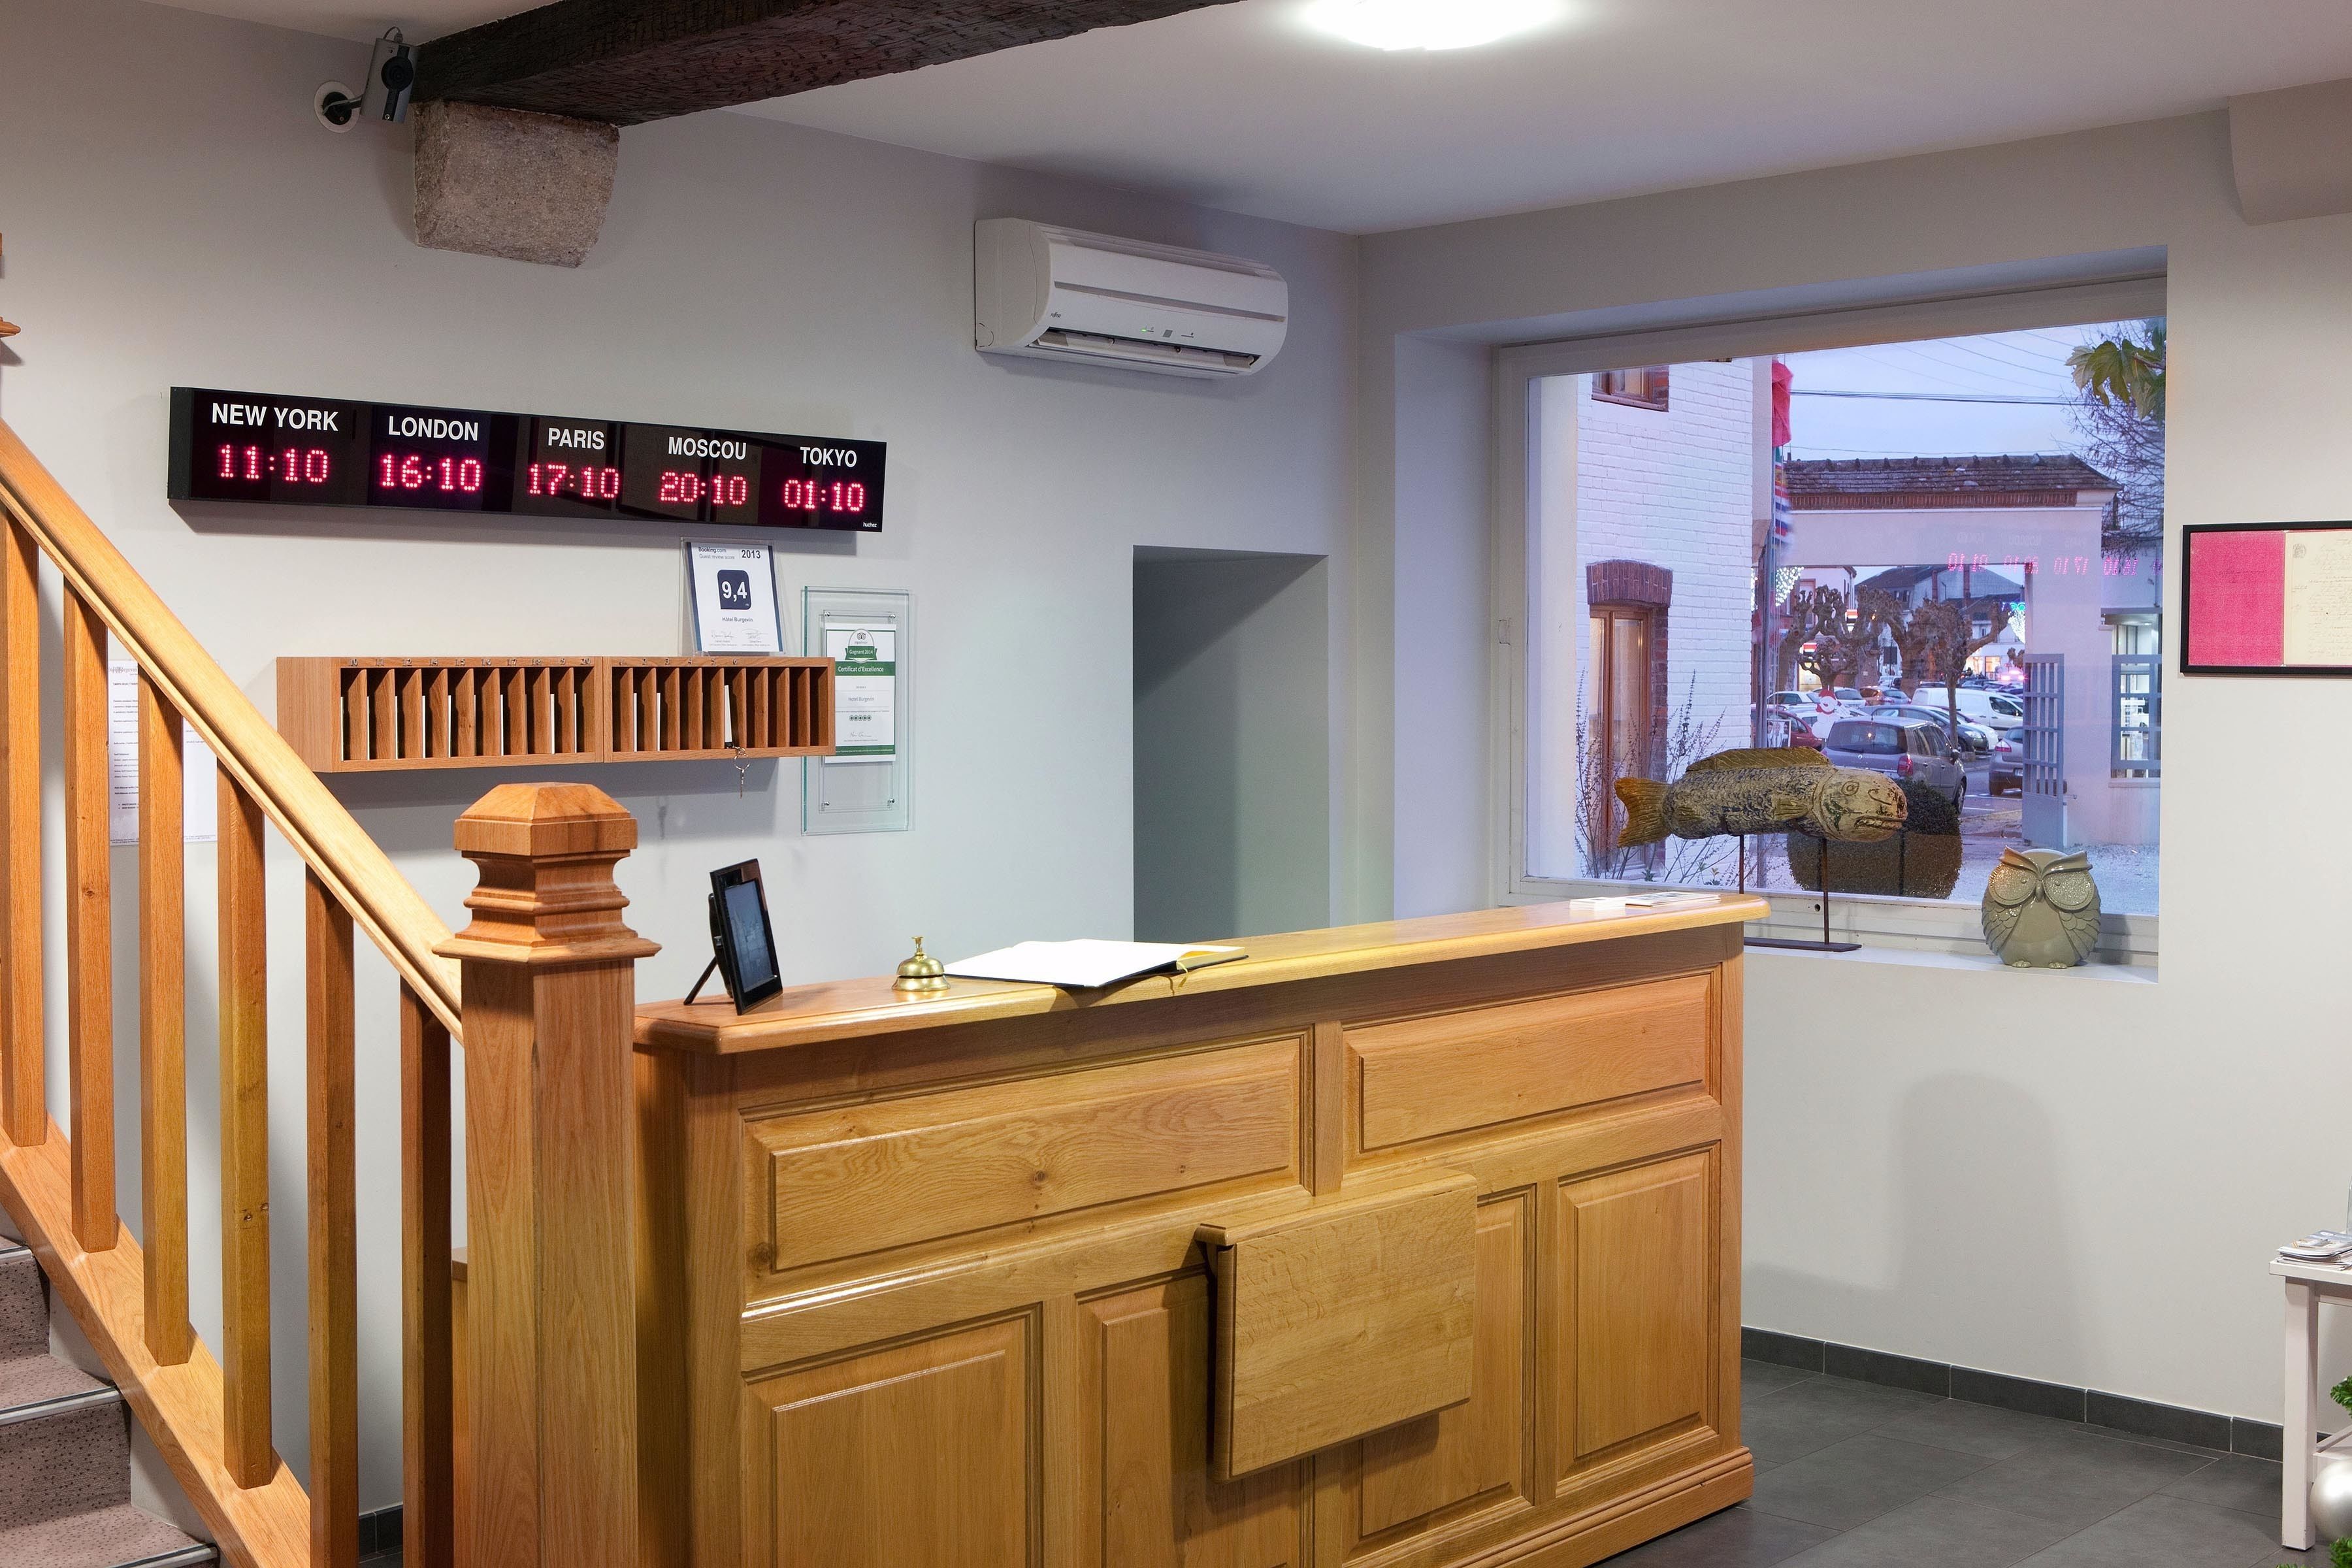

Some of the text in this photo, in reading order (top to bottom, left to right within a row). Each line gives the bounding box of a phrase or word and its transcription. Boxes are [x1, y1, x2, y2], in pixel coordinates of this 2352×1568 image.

[212, 402, 338, 432] NEW YORK
[388, 416, 479, 441] LONDON
[547, 427, 605, 450] PARIS
[668, 436, 747, 460] MOSCOU
[220, 444, 329, 483] 11:10
[800, 446, 857, 468] TOKYO
[380, 454, 481, 491] 16:10
[529, 463, 619, 498] 17:10
[660, 472, 747, 505] 20:10
[784, 480, 864, 512] 01:10
[741, 549, 761, 559] 2013
[721, 581, 747, 602] 9,4
